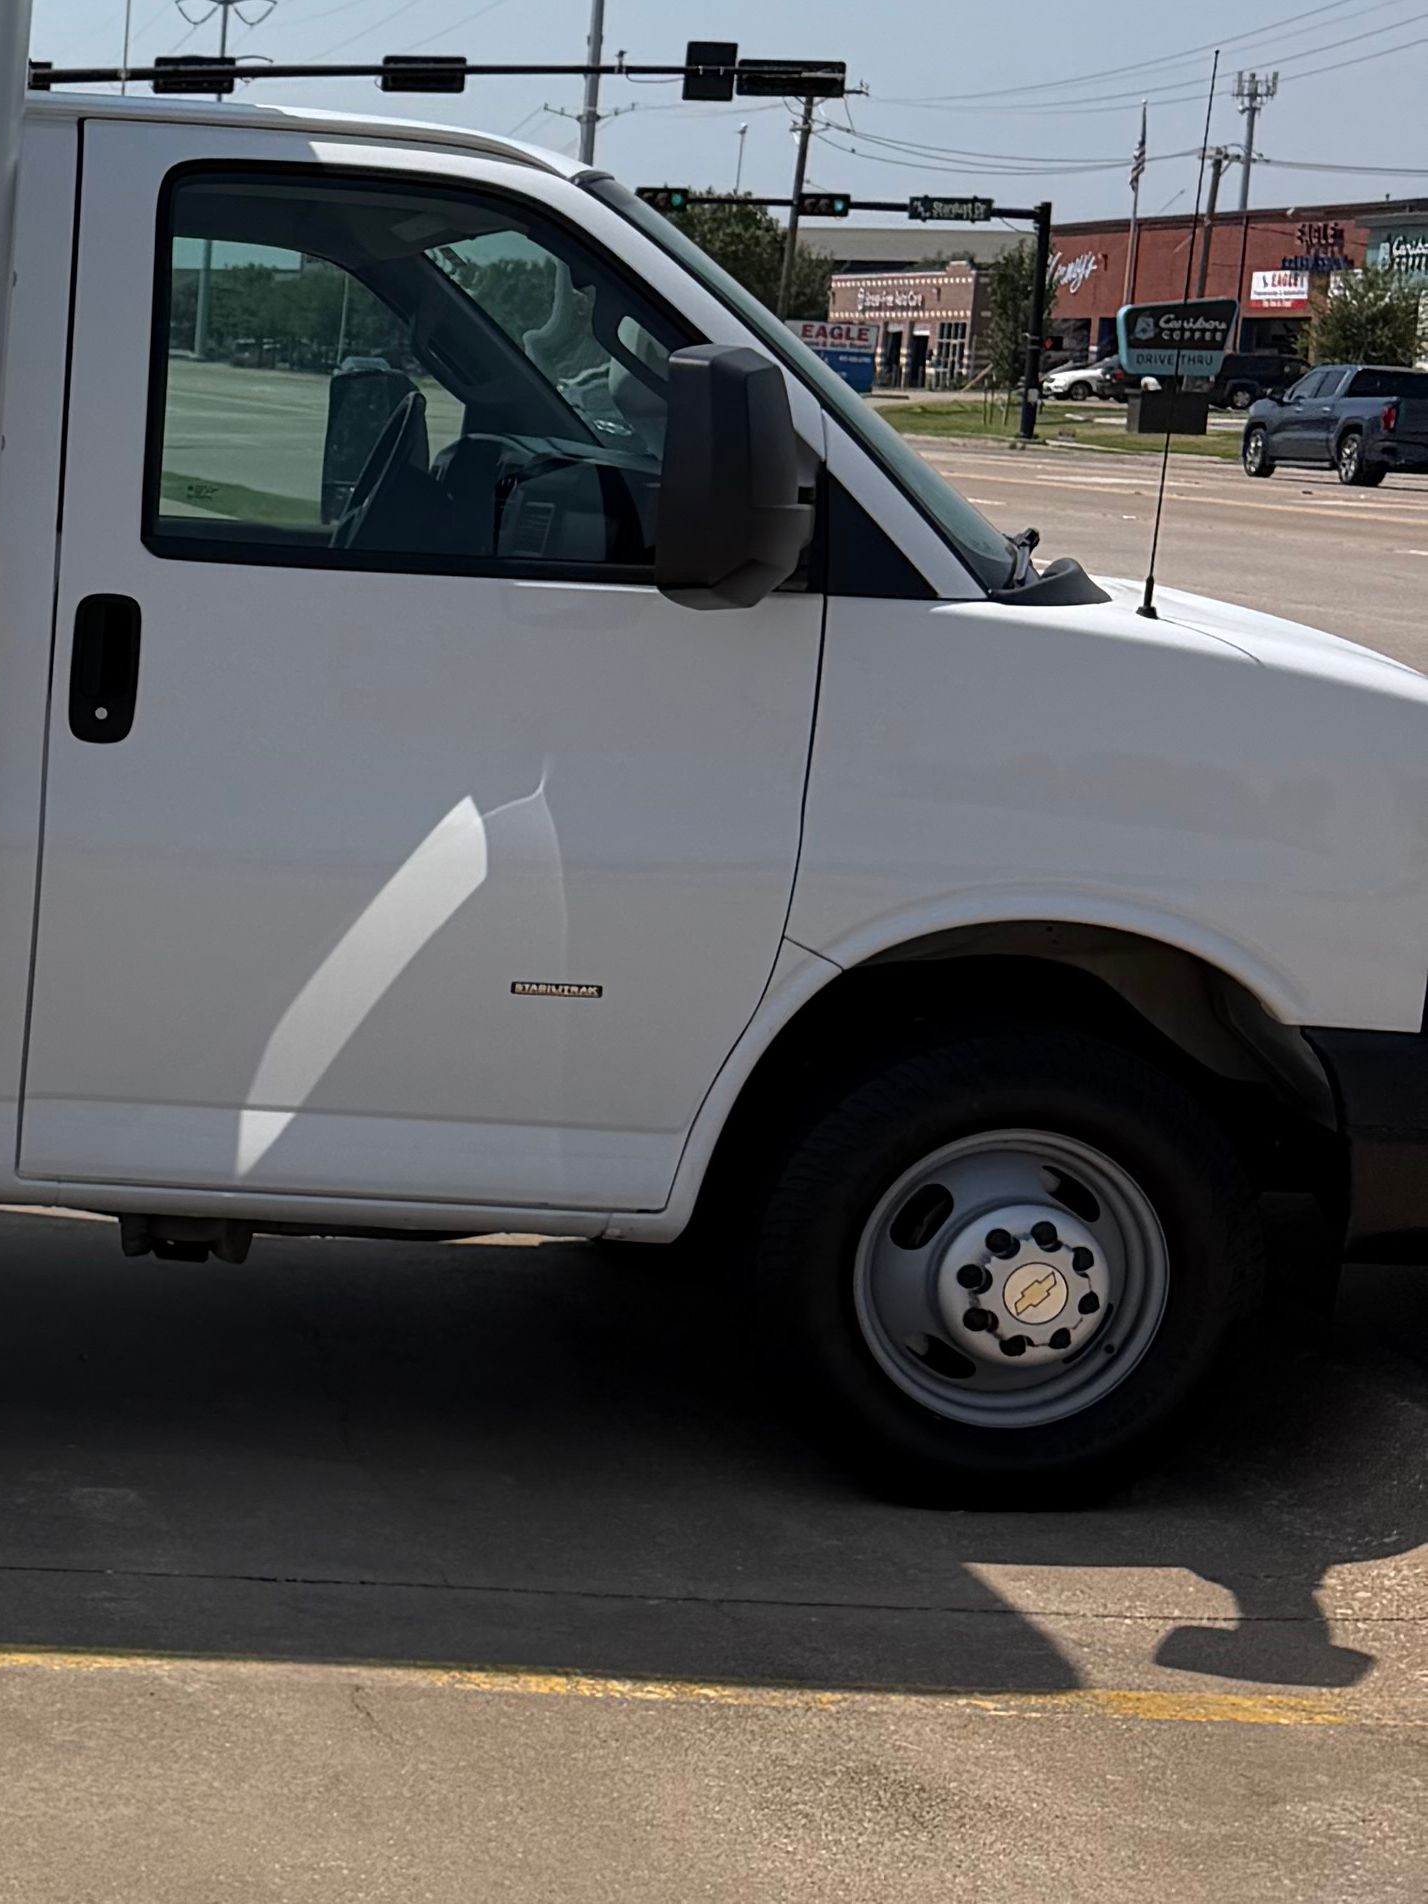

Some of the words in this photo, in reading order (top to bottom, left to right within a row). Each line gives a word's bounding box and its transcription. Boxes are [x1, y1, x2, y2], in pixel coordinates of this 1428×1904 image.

[1159, 314, 1227, 329] Caribou
[801, 324, 870, 342] EAGLE
[1162, 330, 1223, 342] COFFEE
[1136, 354, 1175, 366] DRIVE
[1180, 353, 1213, 366] THRU
[514, 983, 599, 997] STABILITRAK
